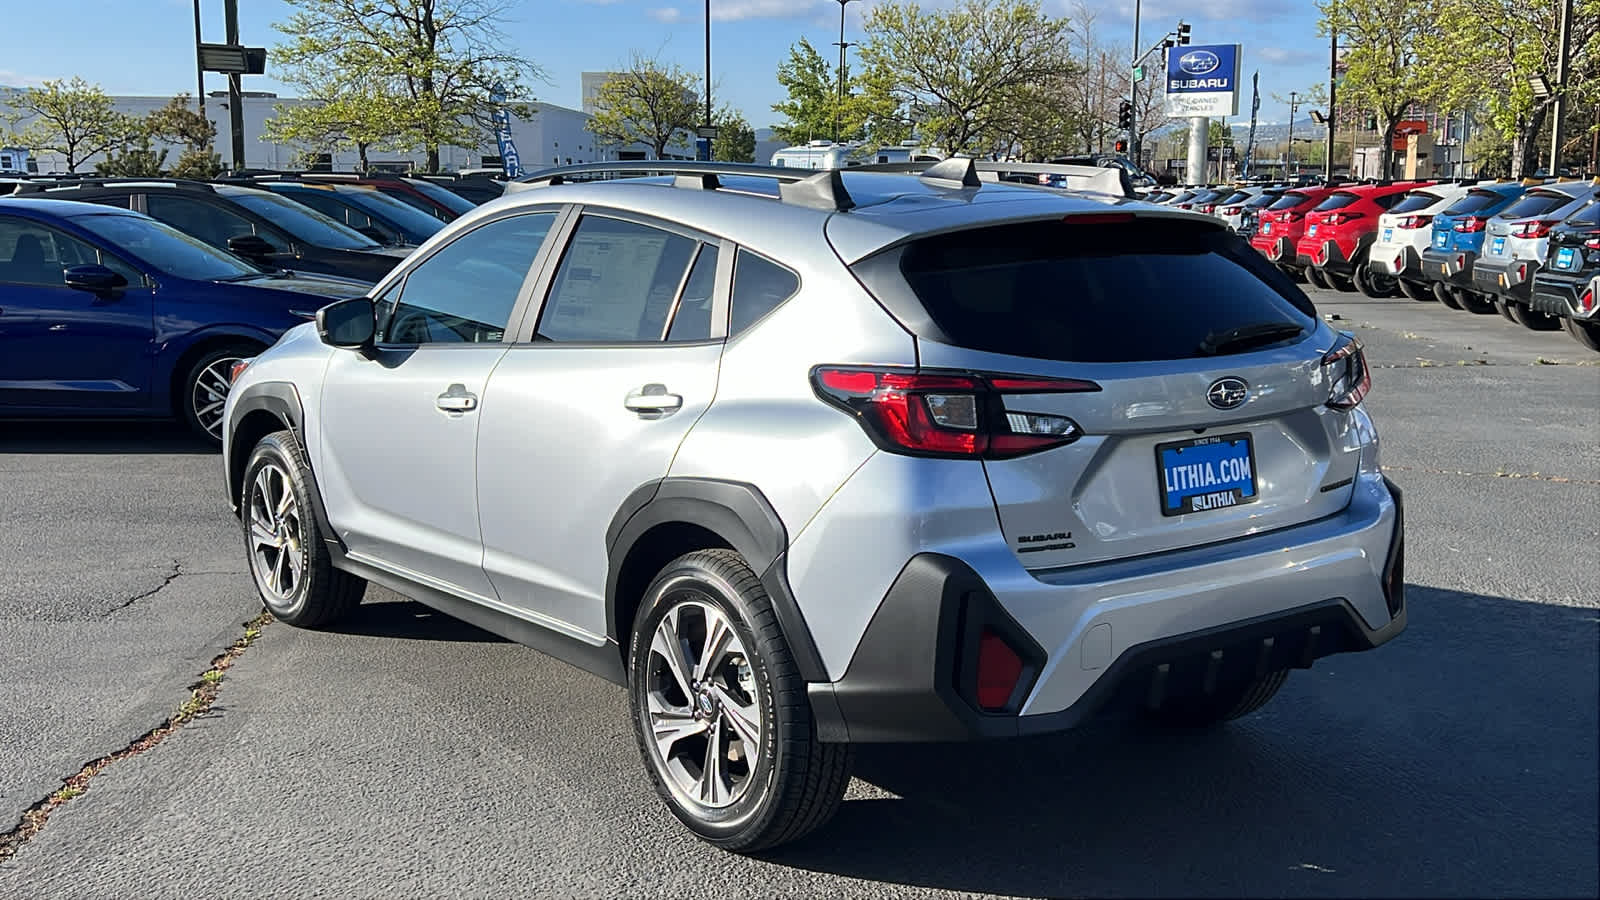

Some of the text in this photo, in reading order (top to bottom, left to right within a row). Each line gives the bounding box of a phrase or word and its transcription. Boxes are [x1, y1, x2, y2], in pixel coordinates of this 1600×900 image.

[1171, 78, 1228, 89] SUBARU
[1164, 456, 1252, 493] LITHIA.COM
[1202, 491, 1236, 509] LITHIA
[1018, 531, 1072, 543] SUBARU
